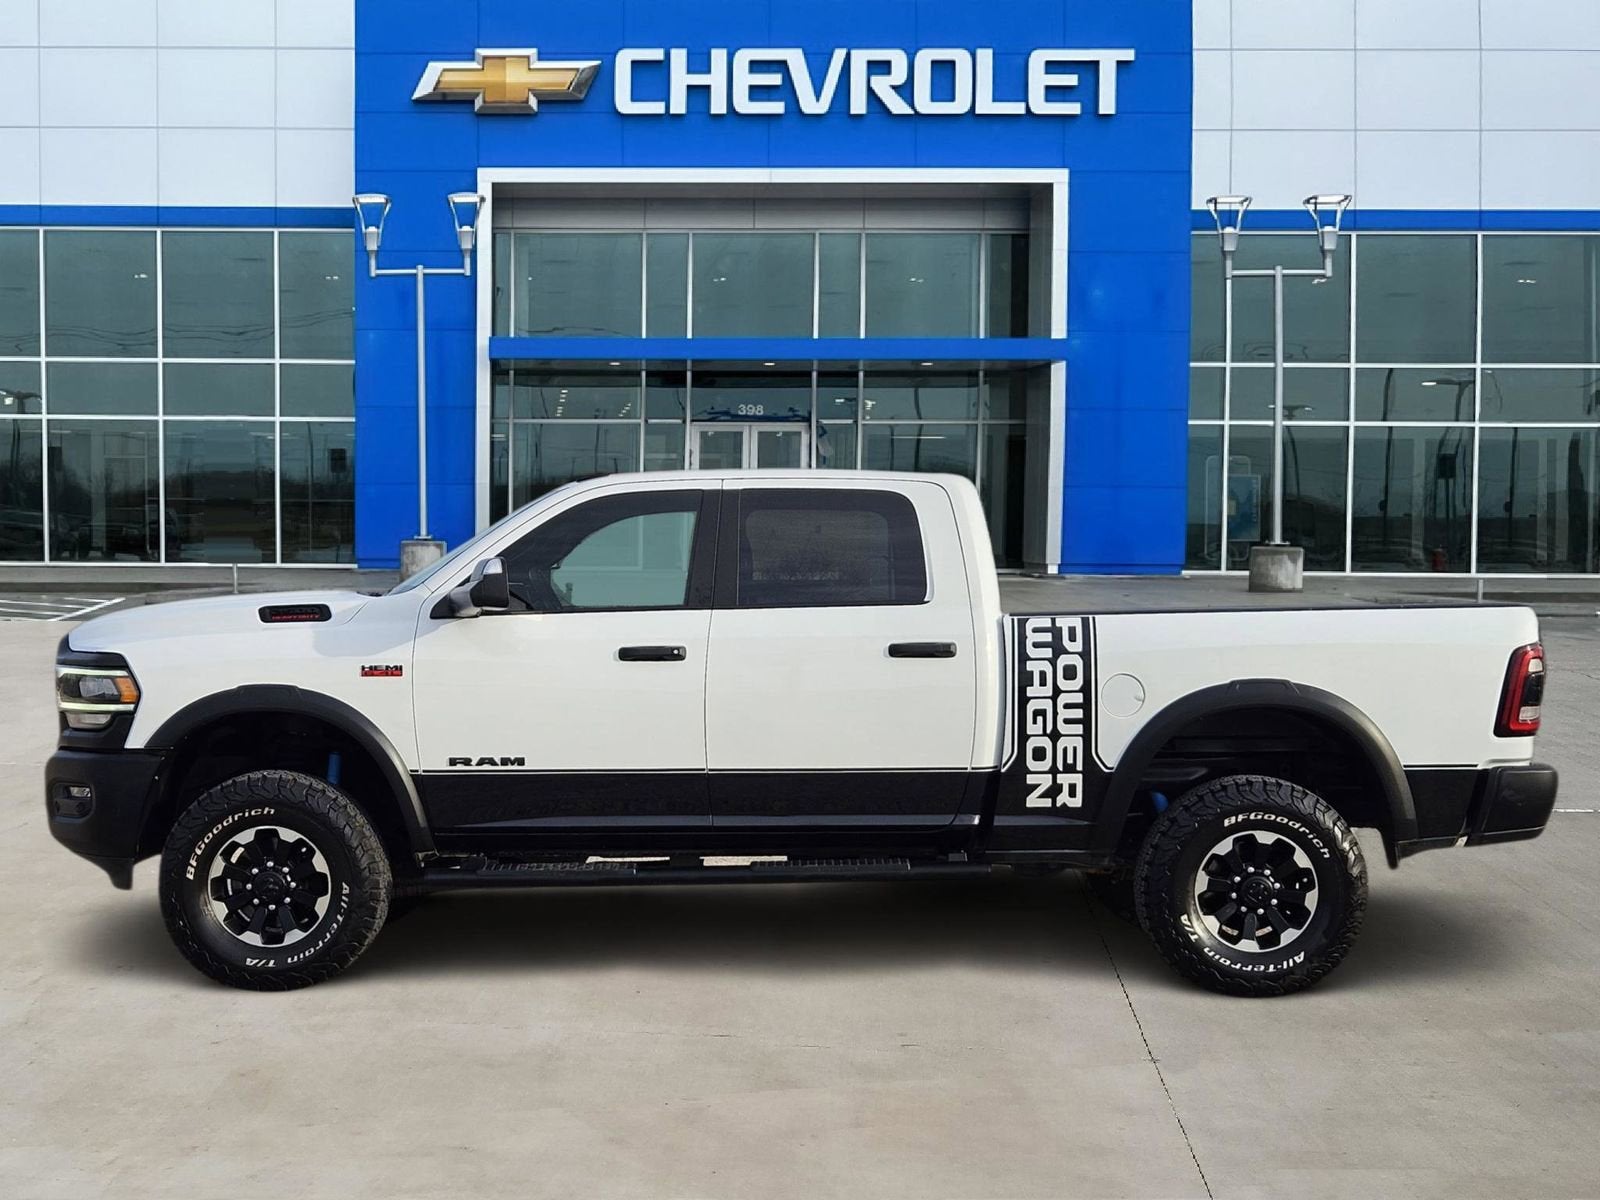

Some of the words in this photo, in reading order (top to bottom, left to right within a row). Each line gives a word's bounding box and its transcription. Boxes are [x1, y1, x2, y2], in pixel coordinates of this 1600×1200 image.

[615, 48, 1135, 115] CHEVROLET
[738, 404, 764, 415] 398
[1025, 618, 1053, 808] WAGON
[1056, 618, 1084, 808] POWER
[448, 757, 526, 767] RAM
[186, 807, 275, 880] BFGoodrich
[1223, 811, 1331, 859] BFGoodrich
[287, 882, 350, 964] All-Terrain
[245, 957, 277, 968] T/A
[1203, 946, 1306, 973] All-Terrain
